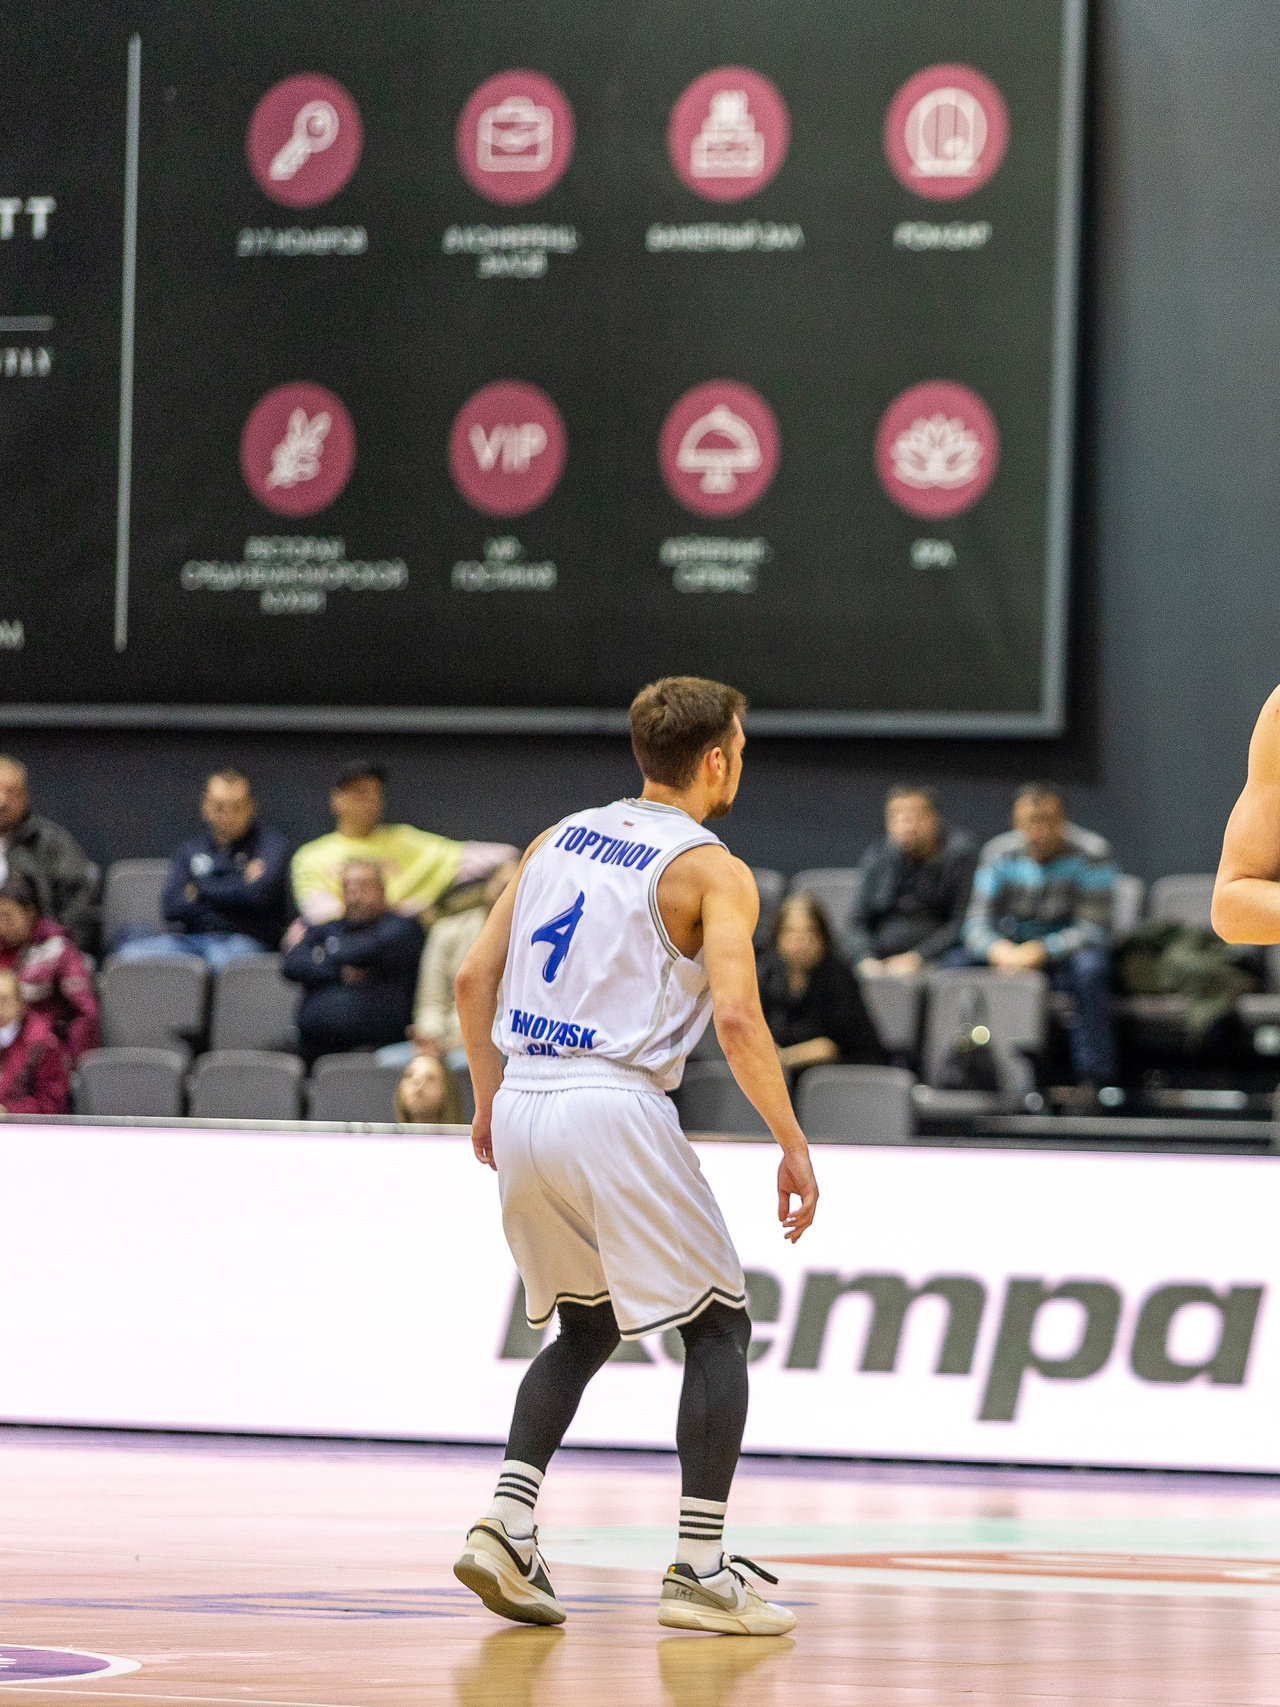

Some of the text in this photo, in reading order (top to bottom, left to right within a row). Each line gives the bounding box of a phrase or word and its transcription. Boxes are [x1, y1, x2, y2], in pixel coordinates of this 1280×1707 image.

[467, 422, 548, 474] VIP
[554, 825, 662, 871] TOPTUNOV
[531, 890, 585, 984] 4
